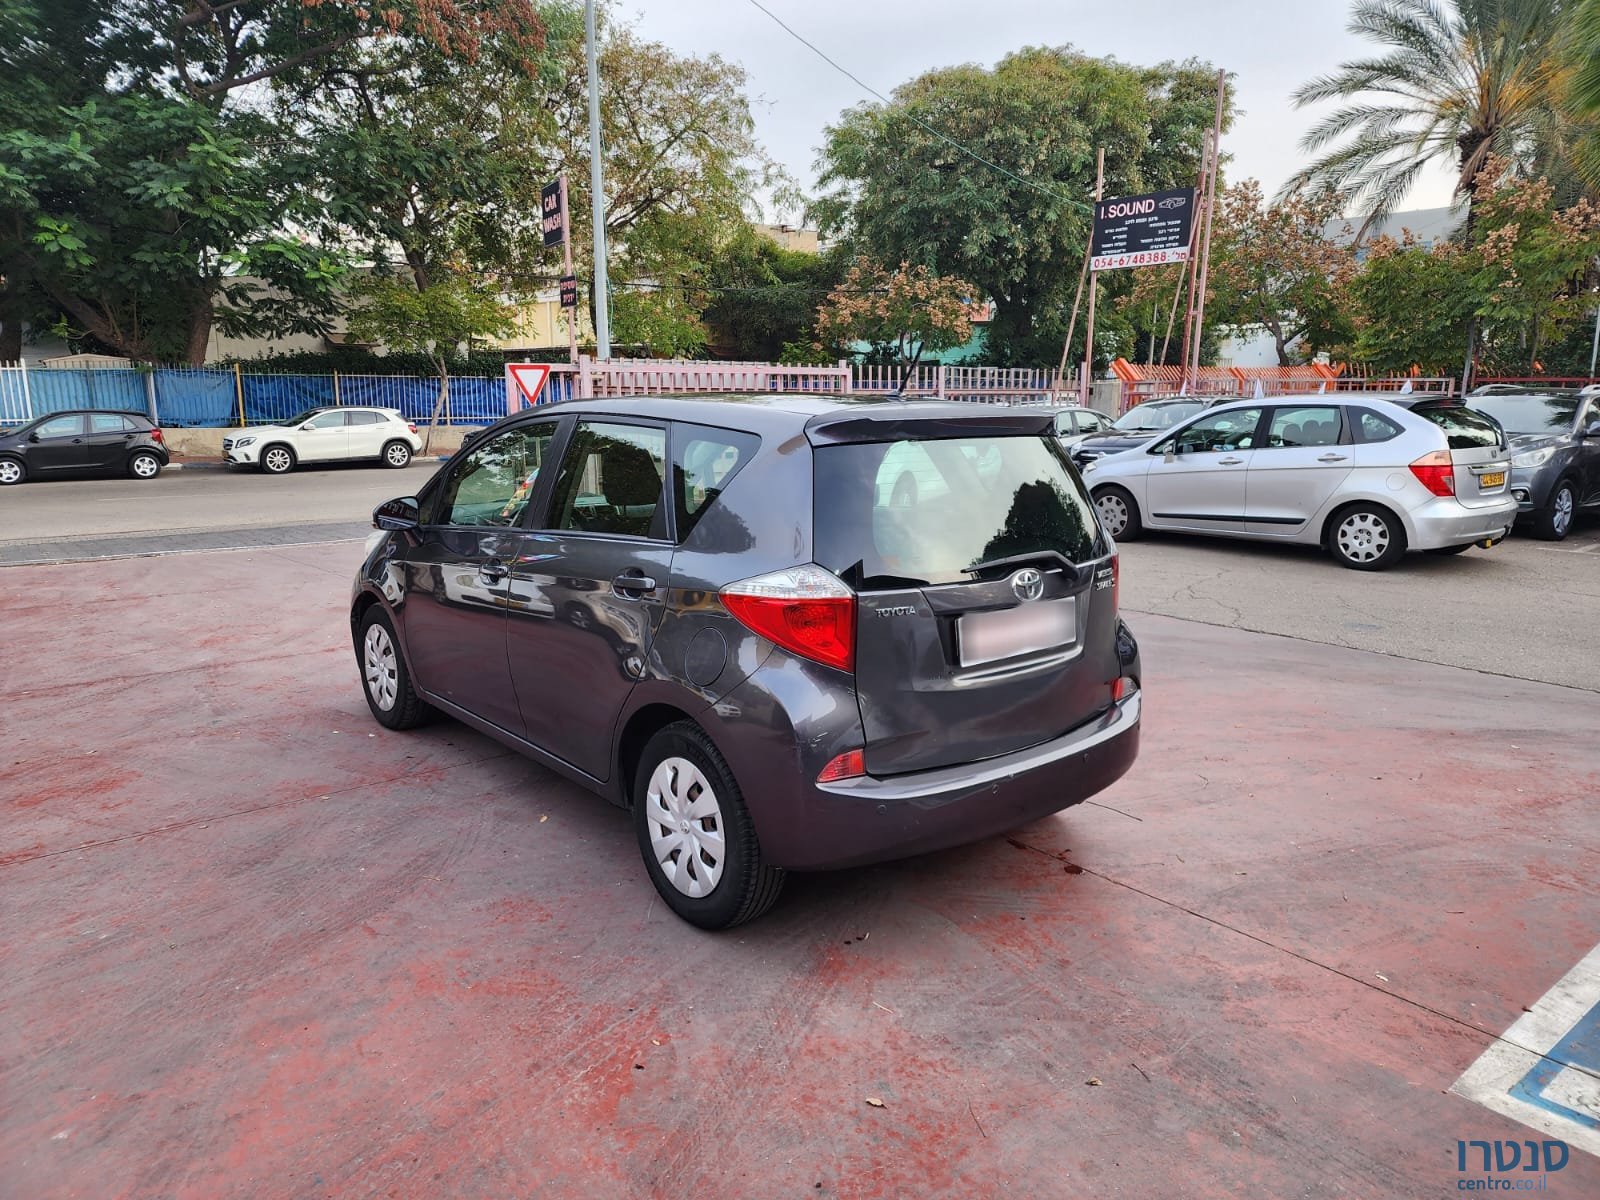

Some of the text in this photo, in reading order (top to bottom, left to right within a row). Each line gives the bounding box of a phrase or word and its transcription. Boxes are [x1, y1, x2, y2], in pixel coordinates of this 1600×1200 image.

[544, 193, 557, 213] CAR
[1100, 199, 1155, 220] I.SOUND
[543, 212, 561, 234] WASH
[1094, 251, 1167, 269] 054-6748388
[875, 605, 916, 618] TOYOTA
